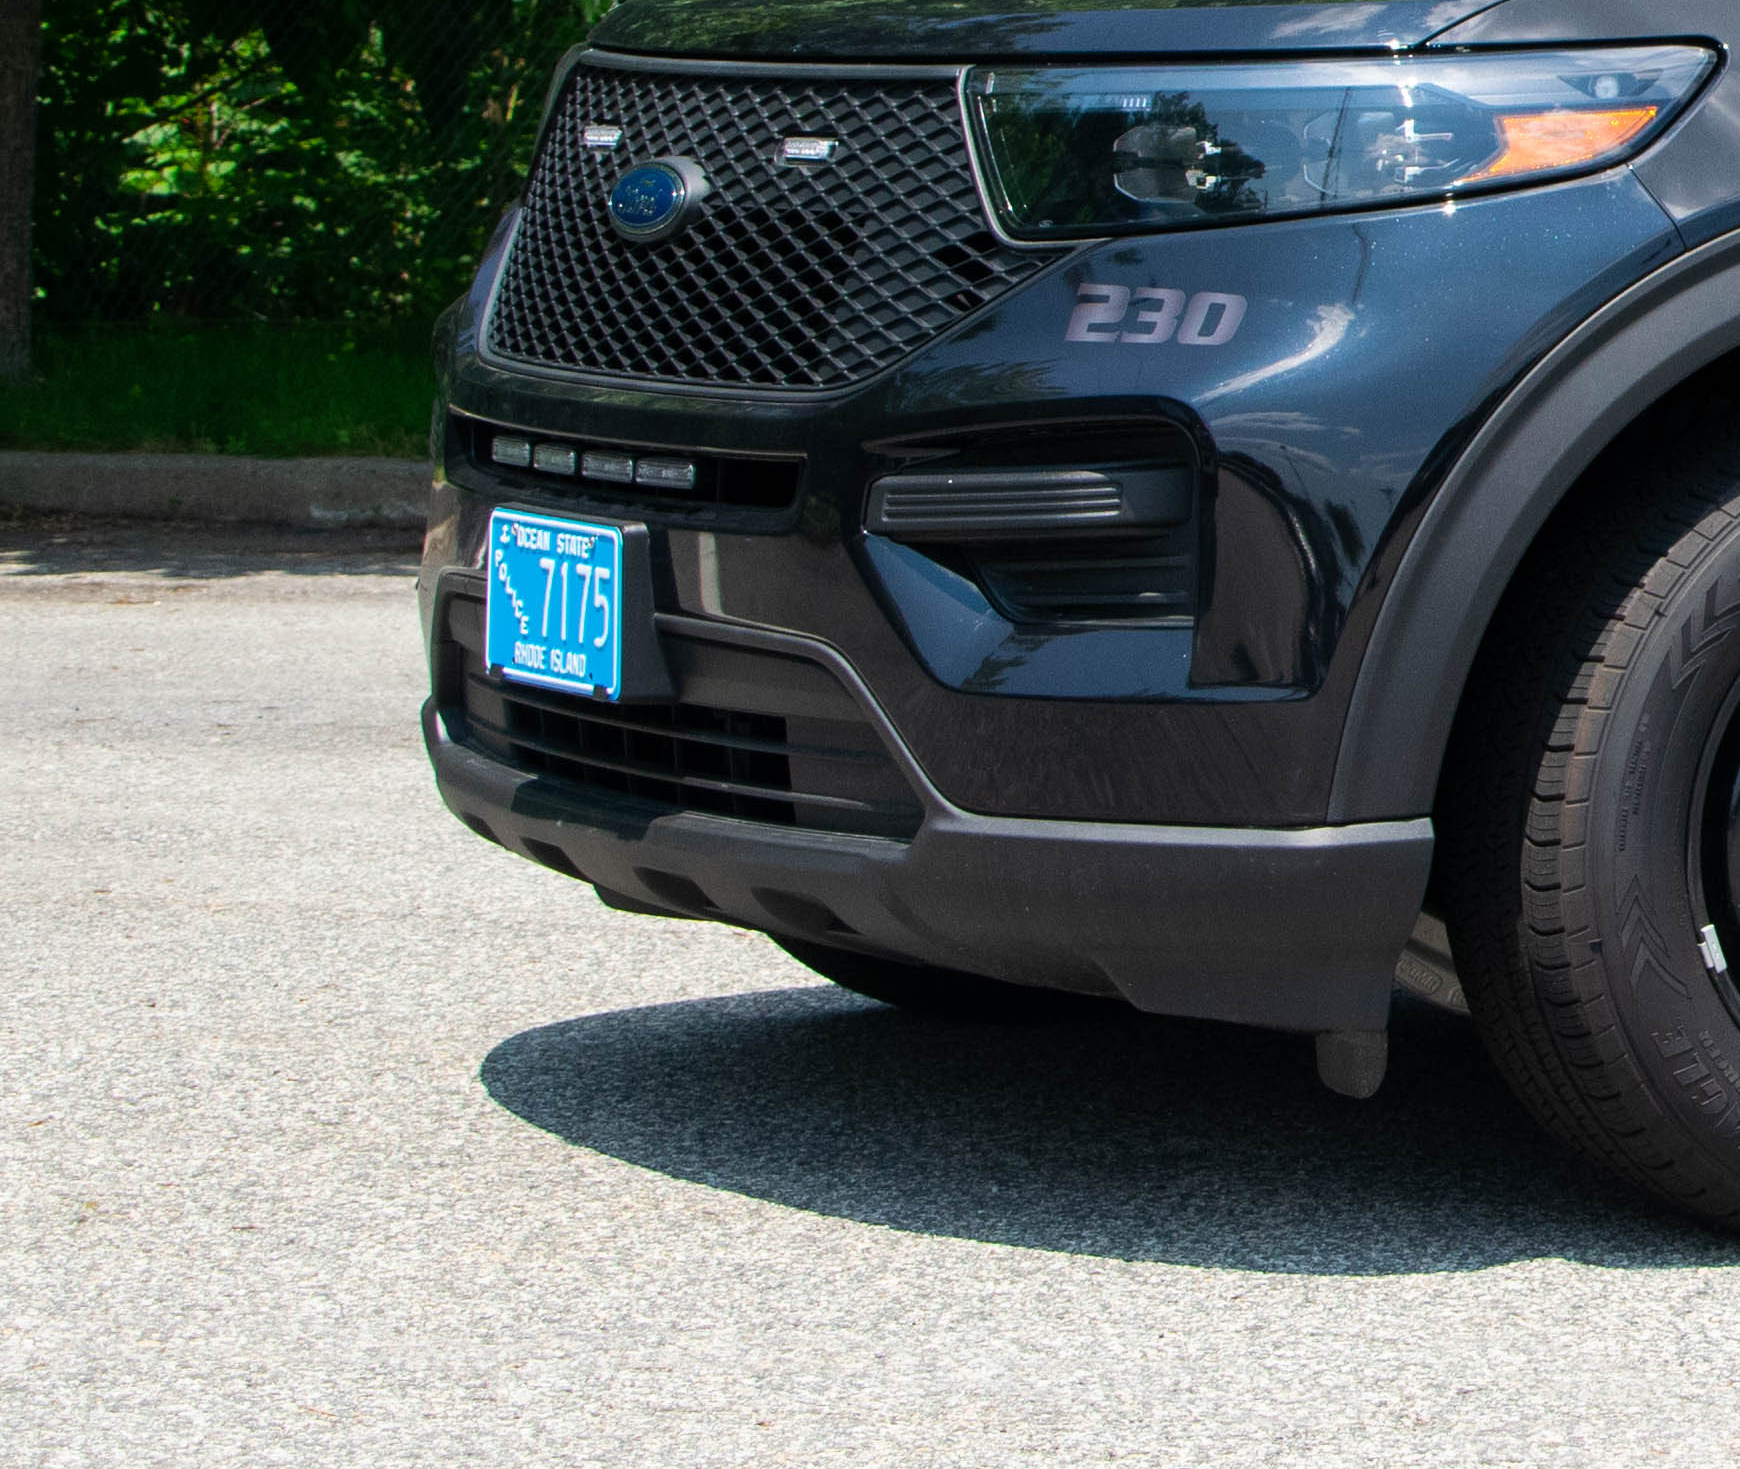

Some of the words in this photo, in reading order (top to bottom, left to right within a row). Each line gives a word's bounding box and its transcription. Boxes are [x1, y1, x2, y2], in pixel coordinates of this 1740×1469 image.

[1064, 282, 1248, 346] 230
[495, 549, 529, 635] POLICE
[539, 557, 611, 648] 7175
[514, 641, 547, 670] RHODE
[550, 648, 587, 678] ISLAND
